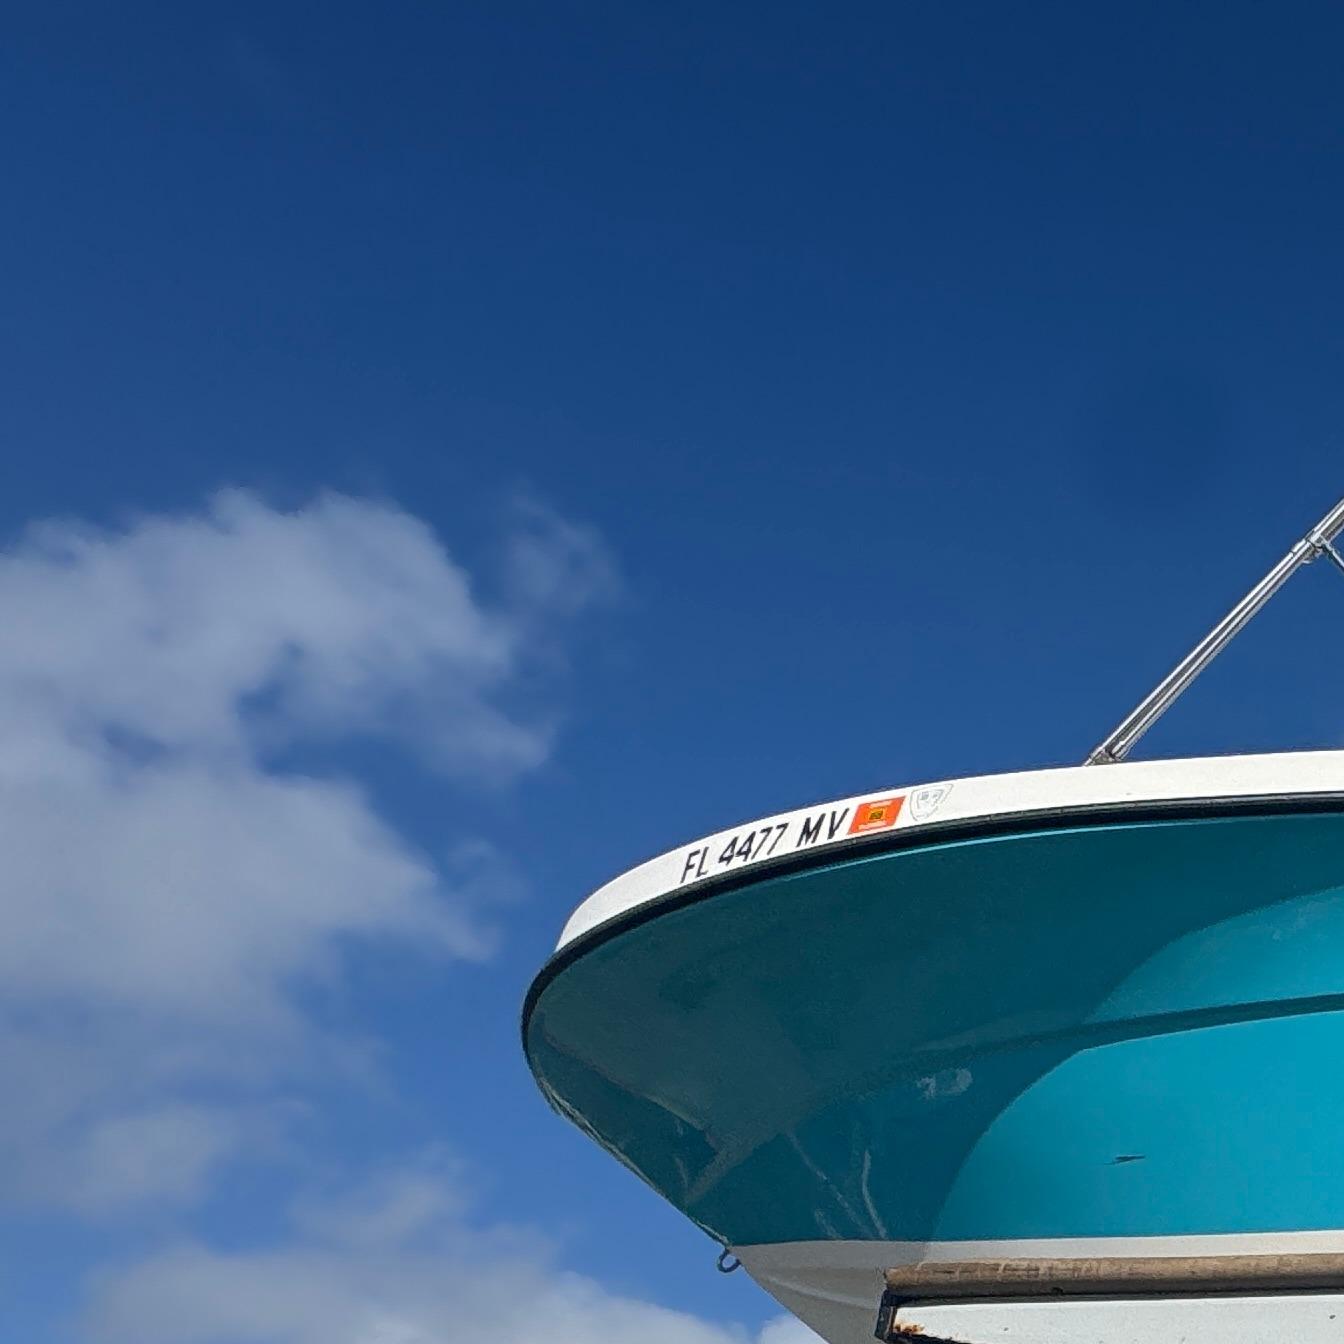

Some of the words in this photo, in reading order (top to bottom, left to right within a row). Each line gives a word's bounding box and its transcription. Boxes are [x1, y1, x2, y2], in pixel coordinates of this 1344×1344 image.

[680, 846, 708, 884] FL
[718, 822, 788, 866] 4477
[796, 807, 849, 847] MV
